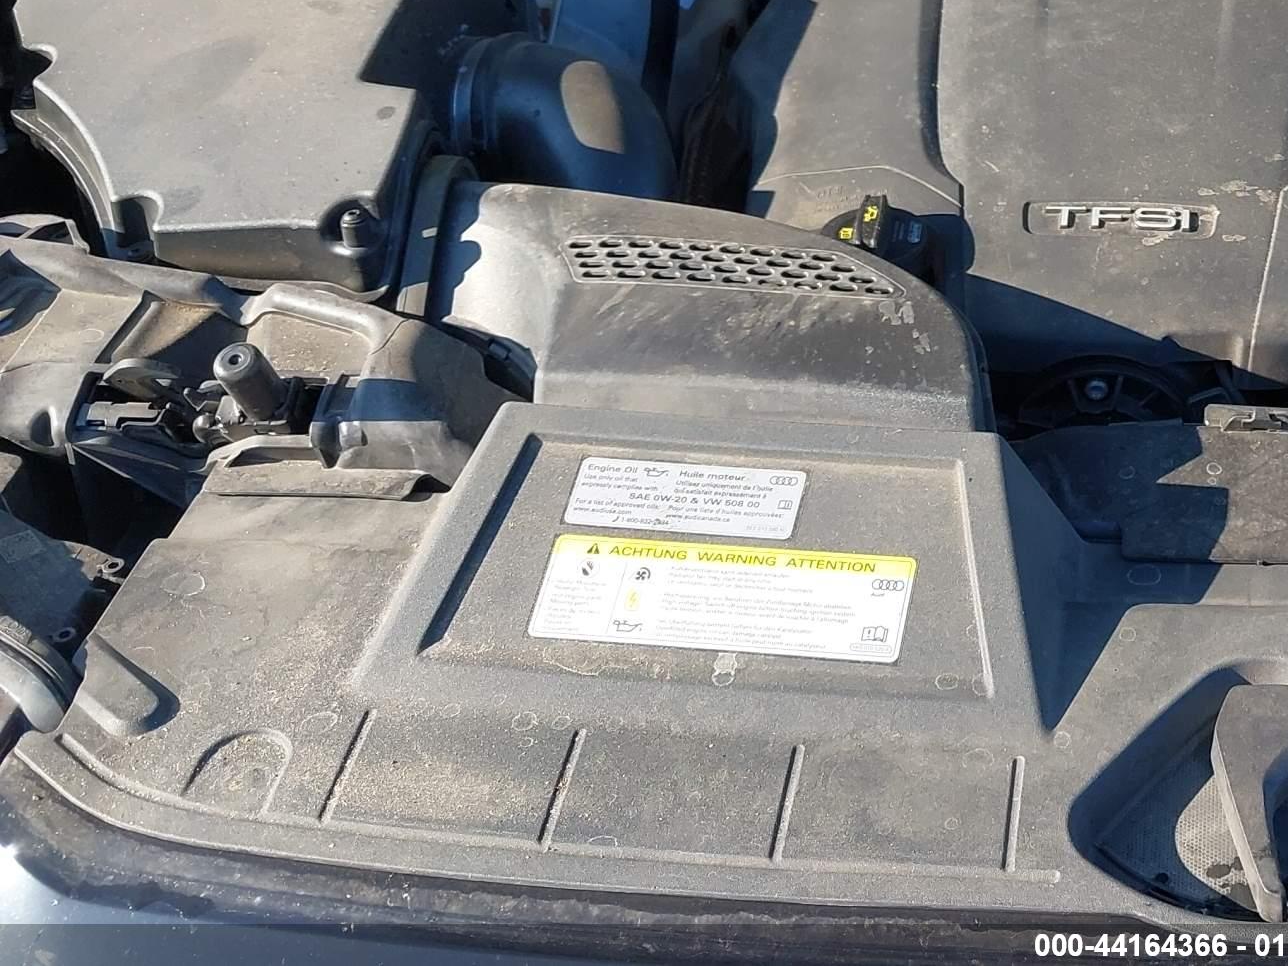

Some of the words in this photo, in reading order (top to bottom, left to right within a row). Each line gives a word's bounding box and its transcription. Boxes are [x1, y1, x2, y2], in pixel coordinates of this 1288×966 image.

[1044, 205, 1198, 232] TFSI
[588, 464, 621, 473] Engine
[624, 466, 639, 474] Oil
[680, 470, 704, 478] Huile
[707, 473, 746, 481] moteur
[629, 493, 651, 501] SAE
[653, 494, 688, 503] 0W-20
[725, 499, 744, 507] 508
[608, 545, 688, 560] ACHTUNG
[698, 552, 777, 566] WARNING
[786, 557, 877, 573] ATTENTION
